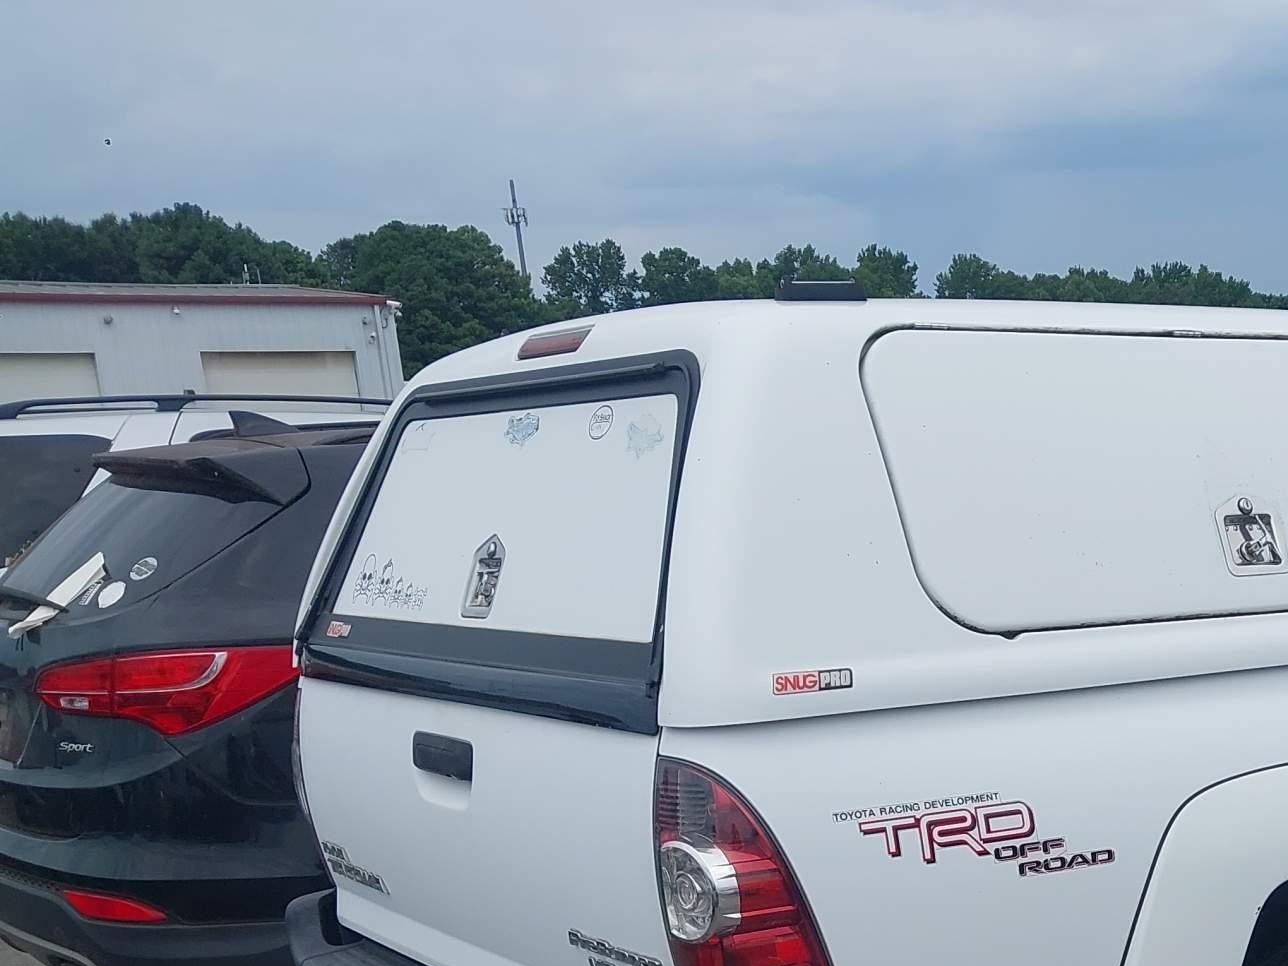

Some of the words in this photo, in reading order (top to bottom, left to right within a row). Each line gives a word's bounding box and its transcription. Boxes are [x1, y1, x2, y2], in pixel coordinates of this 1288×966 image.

[59, 742, 94, 752] Sport
[833, 809, 876, 822] TOYOTA
[879, 803, 921, 816] RACING
[924, 792, 999, 810] DEVELOPMENT
[858, 801, 1036, 863] TRD
[994, 838, 1066, 862] OFF
[1018, 849, 1116, 877] ROAD
